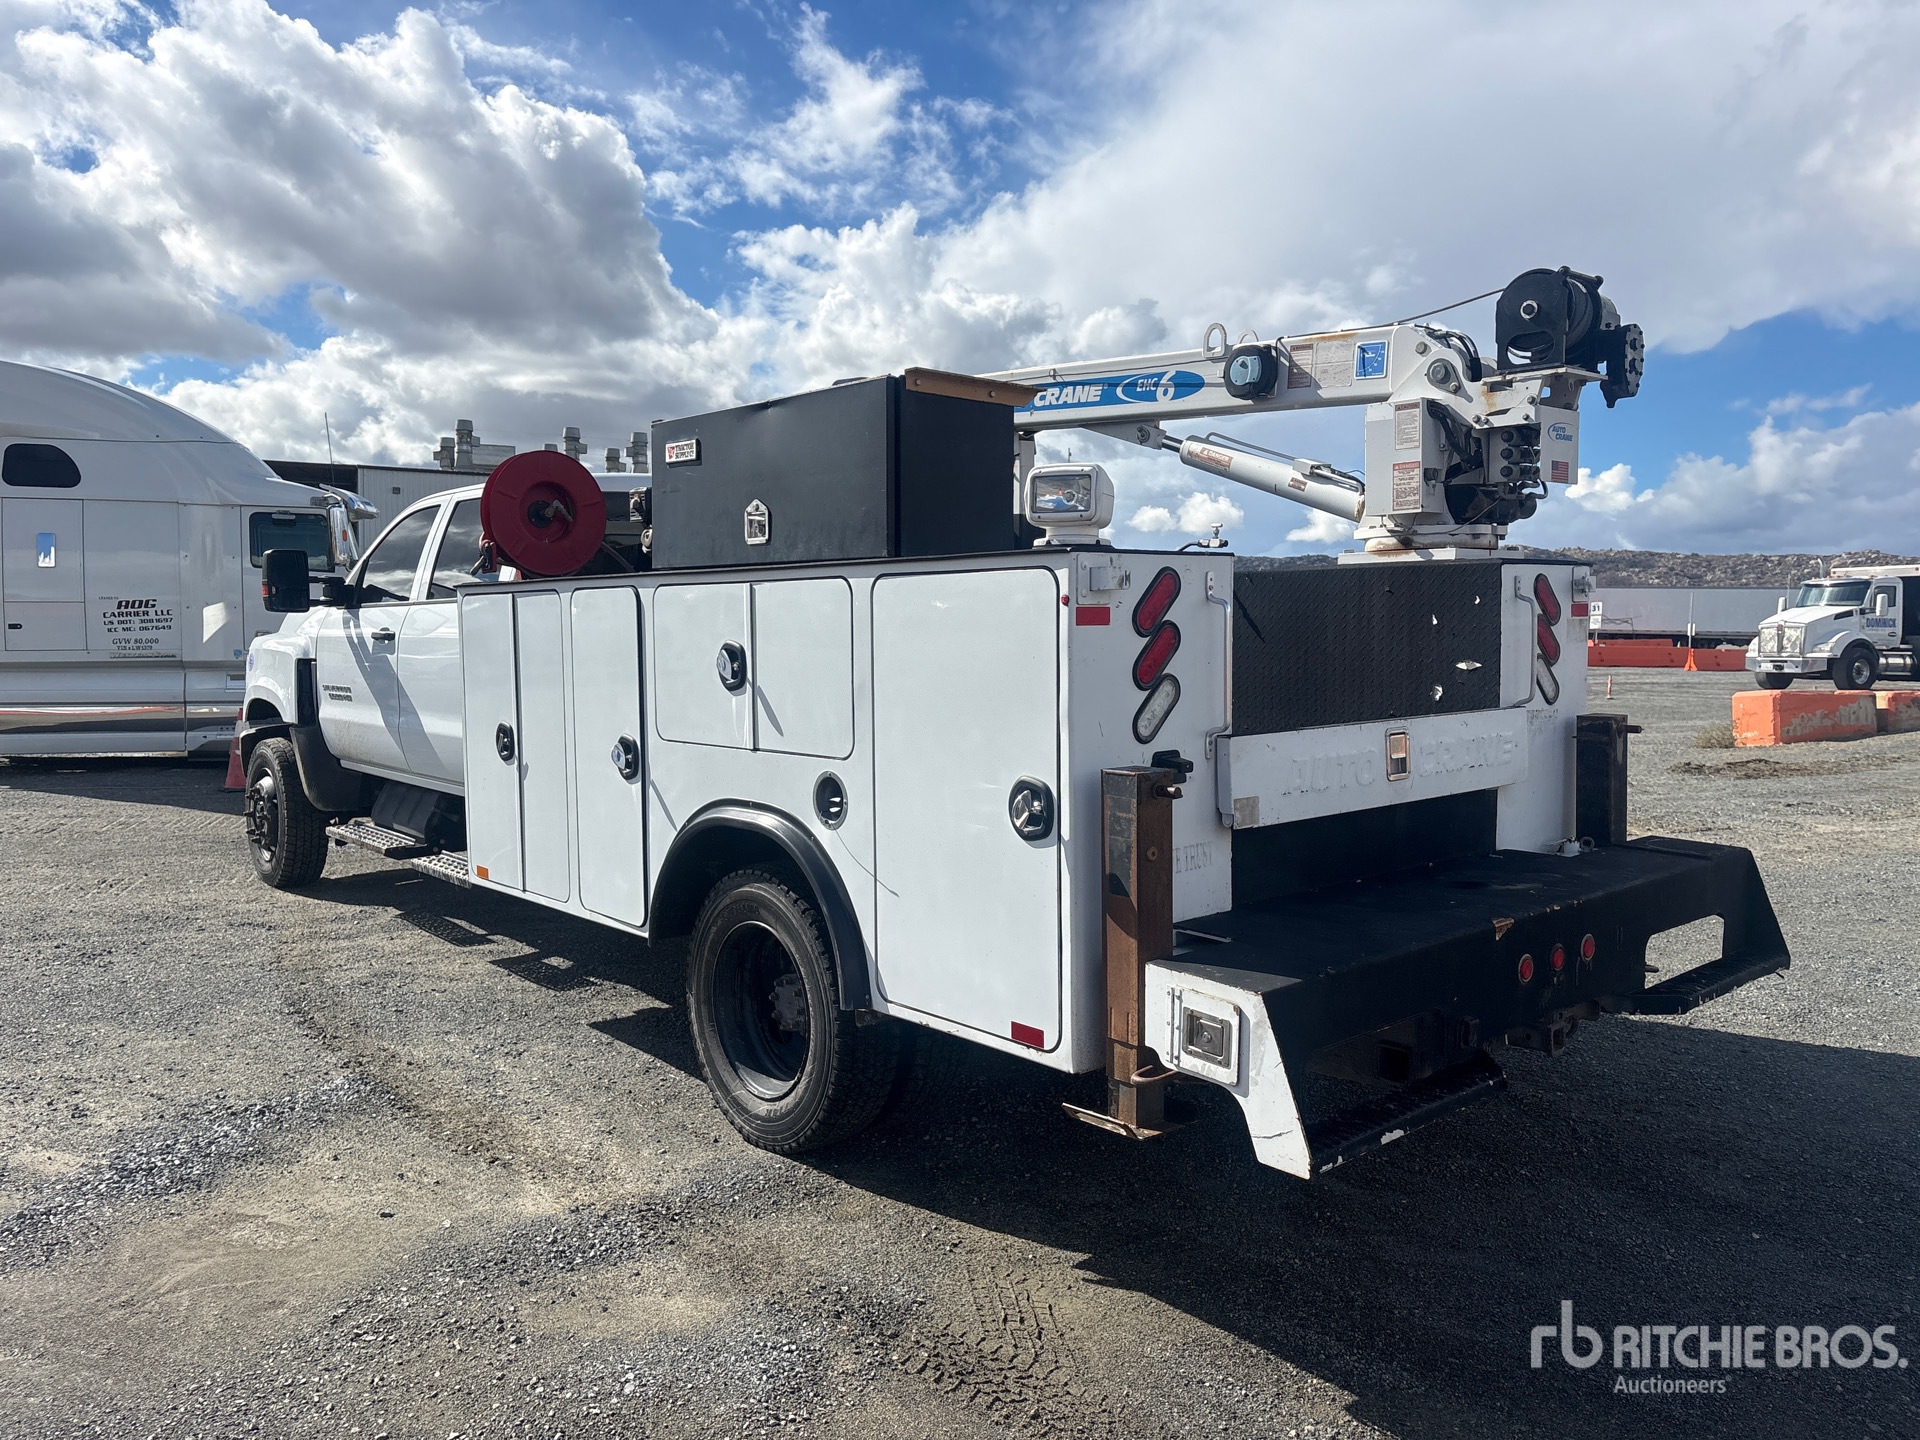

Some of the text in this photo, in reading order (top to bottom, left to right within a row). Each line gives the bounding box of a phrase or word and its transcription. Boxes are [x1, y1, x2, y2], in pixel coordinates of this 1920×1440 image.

[1136, 370, 1177, 402] EHC 6
[1555, 433, 1573, 441] CRANE
[675, 442, 694, 452] TRACTOR
[1208, 450, 1231, 462] DANGER
[116, 599, 157, 610] AOG
[102, 609, 173, 619] CARRIER LLC
[1866, 617, 1897, 628] DOMINICK
[133, 637, 160, 645] 80,000
